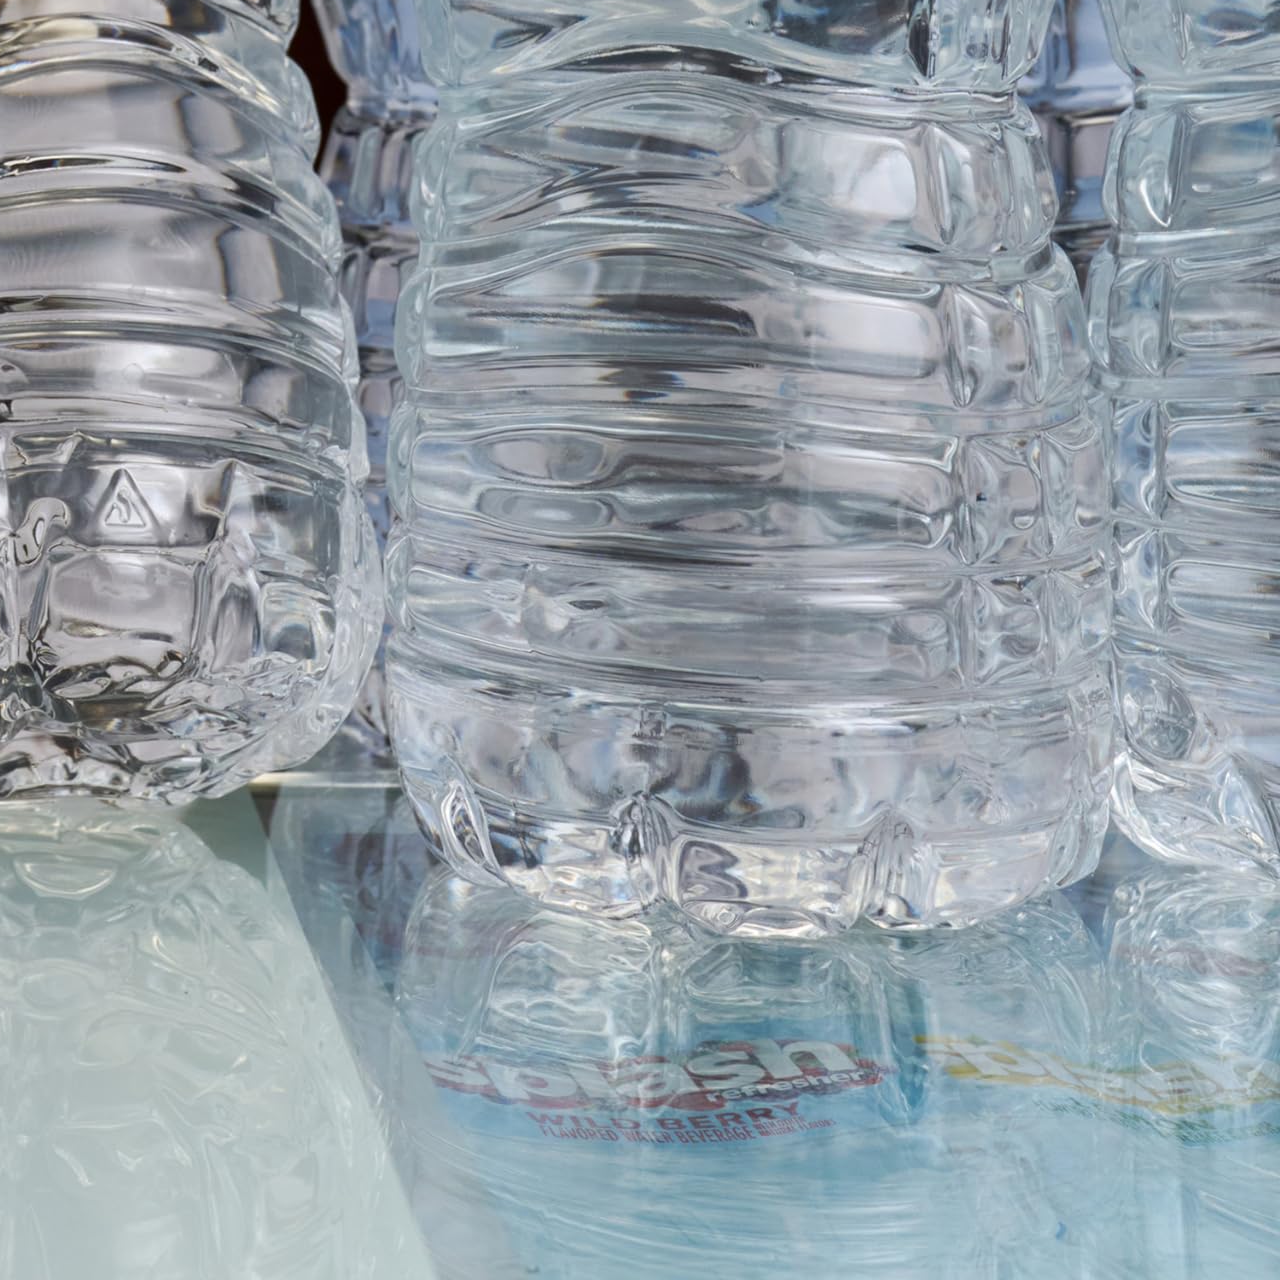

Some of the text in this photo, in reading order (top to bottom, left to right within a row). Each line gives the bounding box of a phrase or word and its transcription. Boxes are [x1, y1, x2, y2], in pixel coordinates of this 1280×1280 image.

[426, 1039, 858, 1102] splash
[706, 1069, 866, 1104] refresher
[526, 1111, 637, 1131] WILD
[659, 1101, 801, 1131] BERRY
[676, 1125, 756, 1145] BEVERAGE
